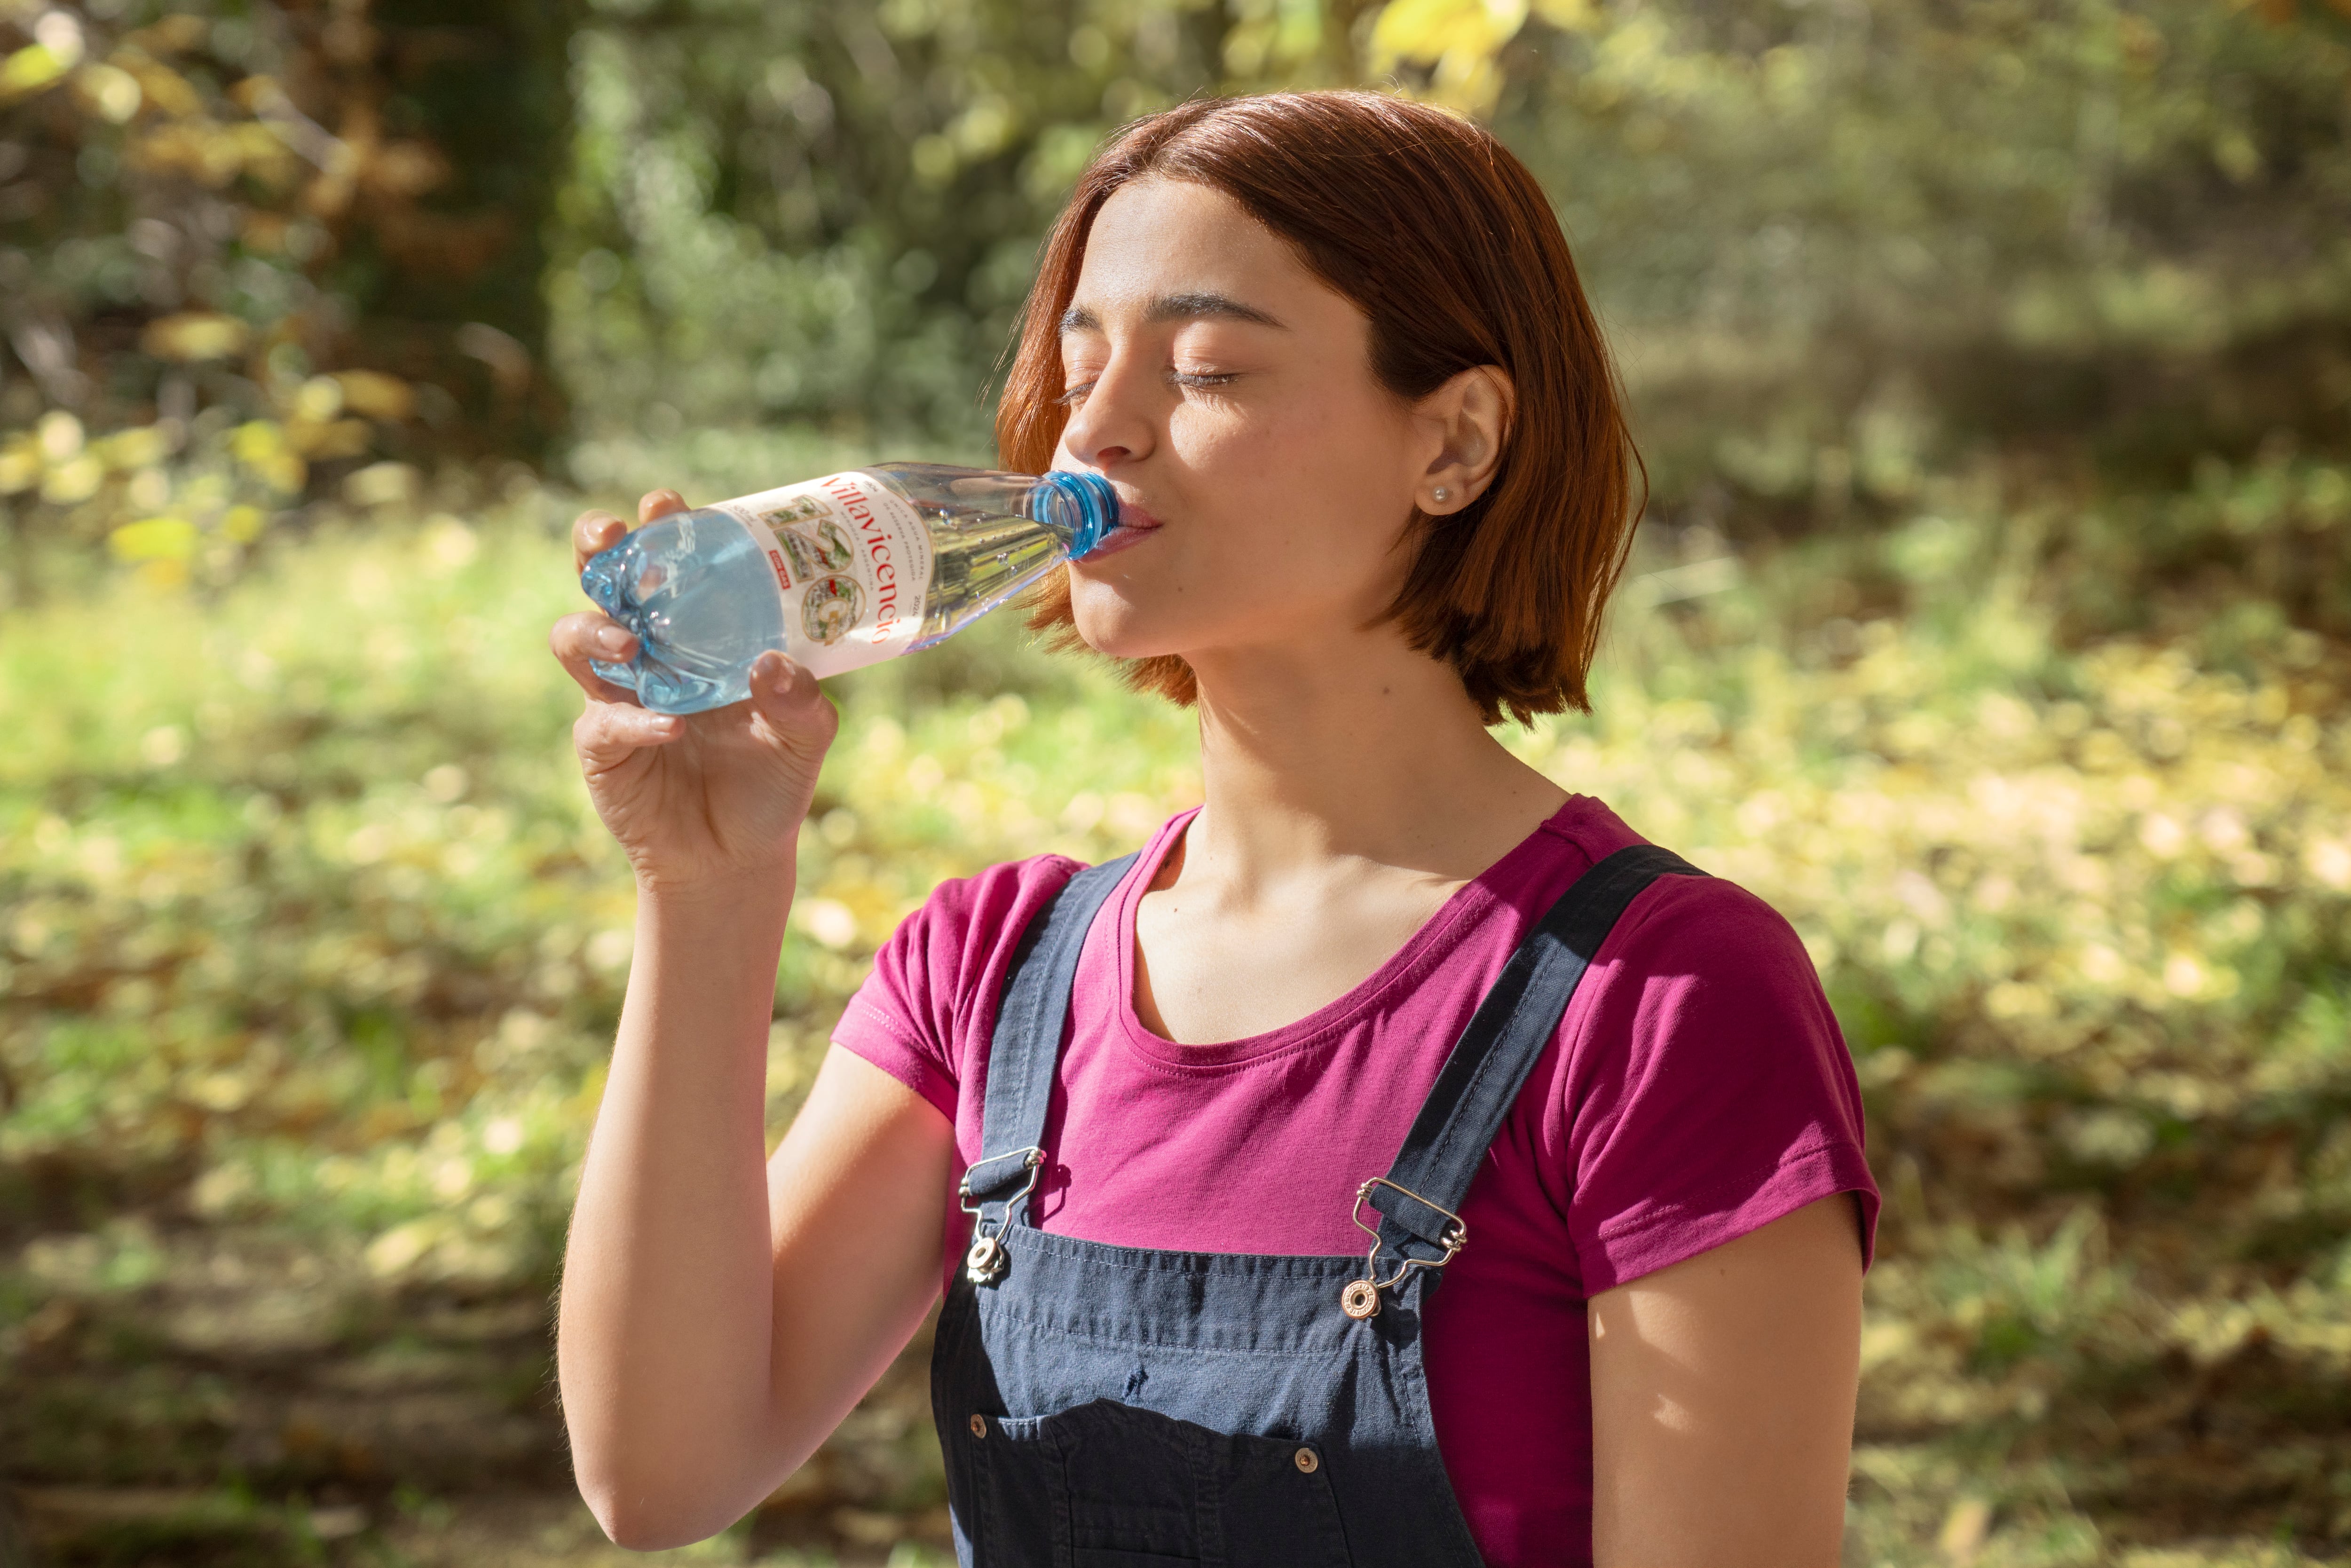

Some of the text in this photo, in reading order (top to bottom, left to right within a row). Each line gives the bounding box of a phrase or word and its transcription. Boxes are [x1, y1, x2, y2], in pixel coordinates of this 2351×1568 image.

[841, 511, 874, 591] MENDOZA ARGENTINA
[890, 512, 906, 539] RESERVA
[904, 541, 916, 581] PROTEGIDA
[908, 521, 920, 541] AGUA
[771, 552, 789, 587] CON GAS
[821, 477, 900, 644] Villavicencio
[912, 595, 921, 617] 2024
